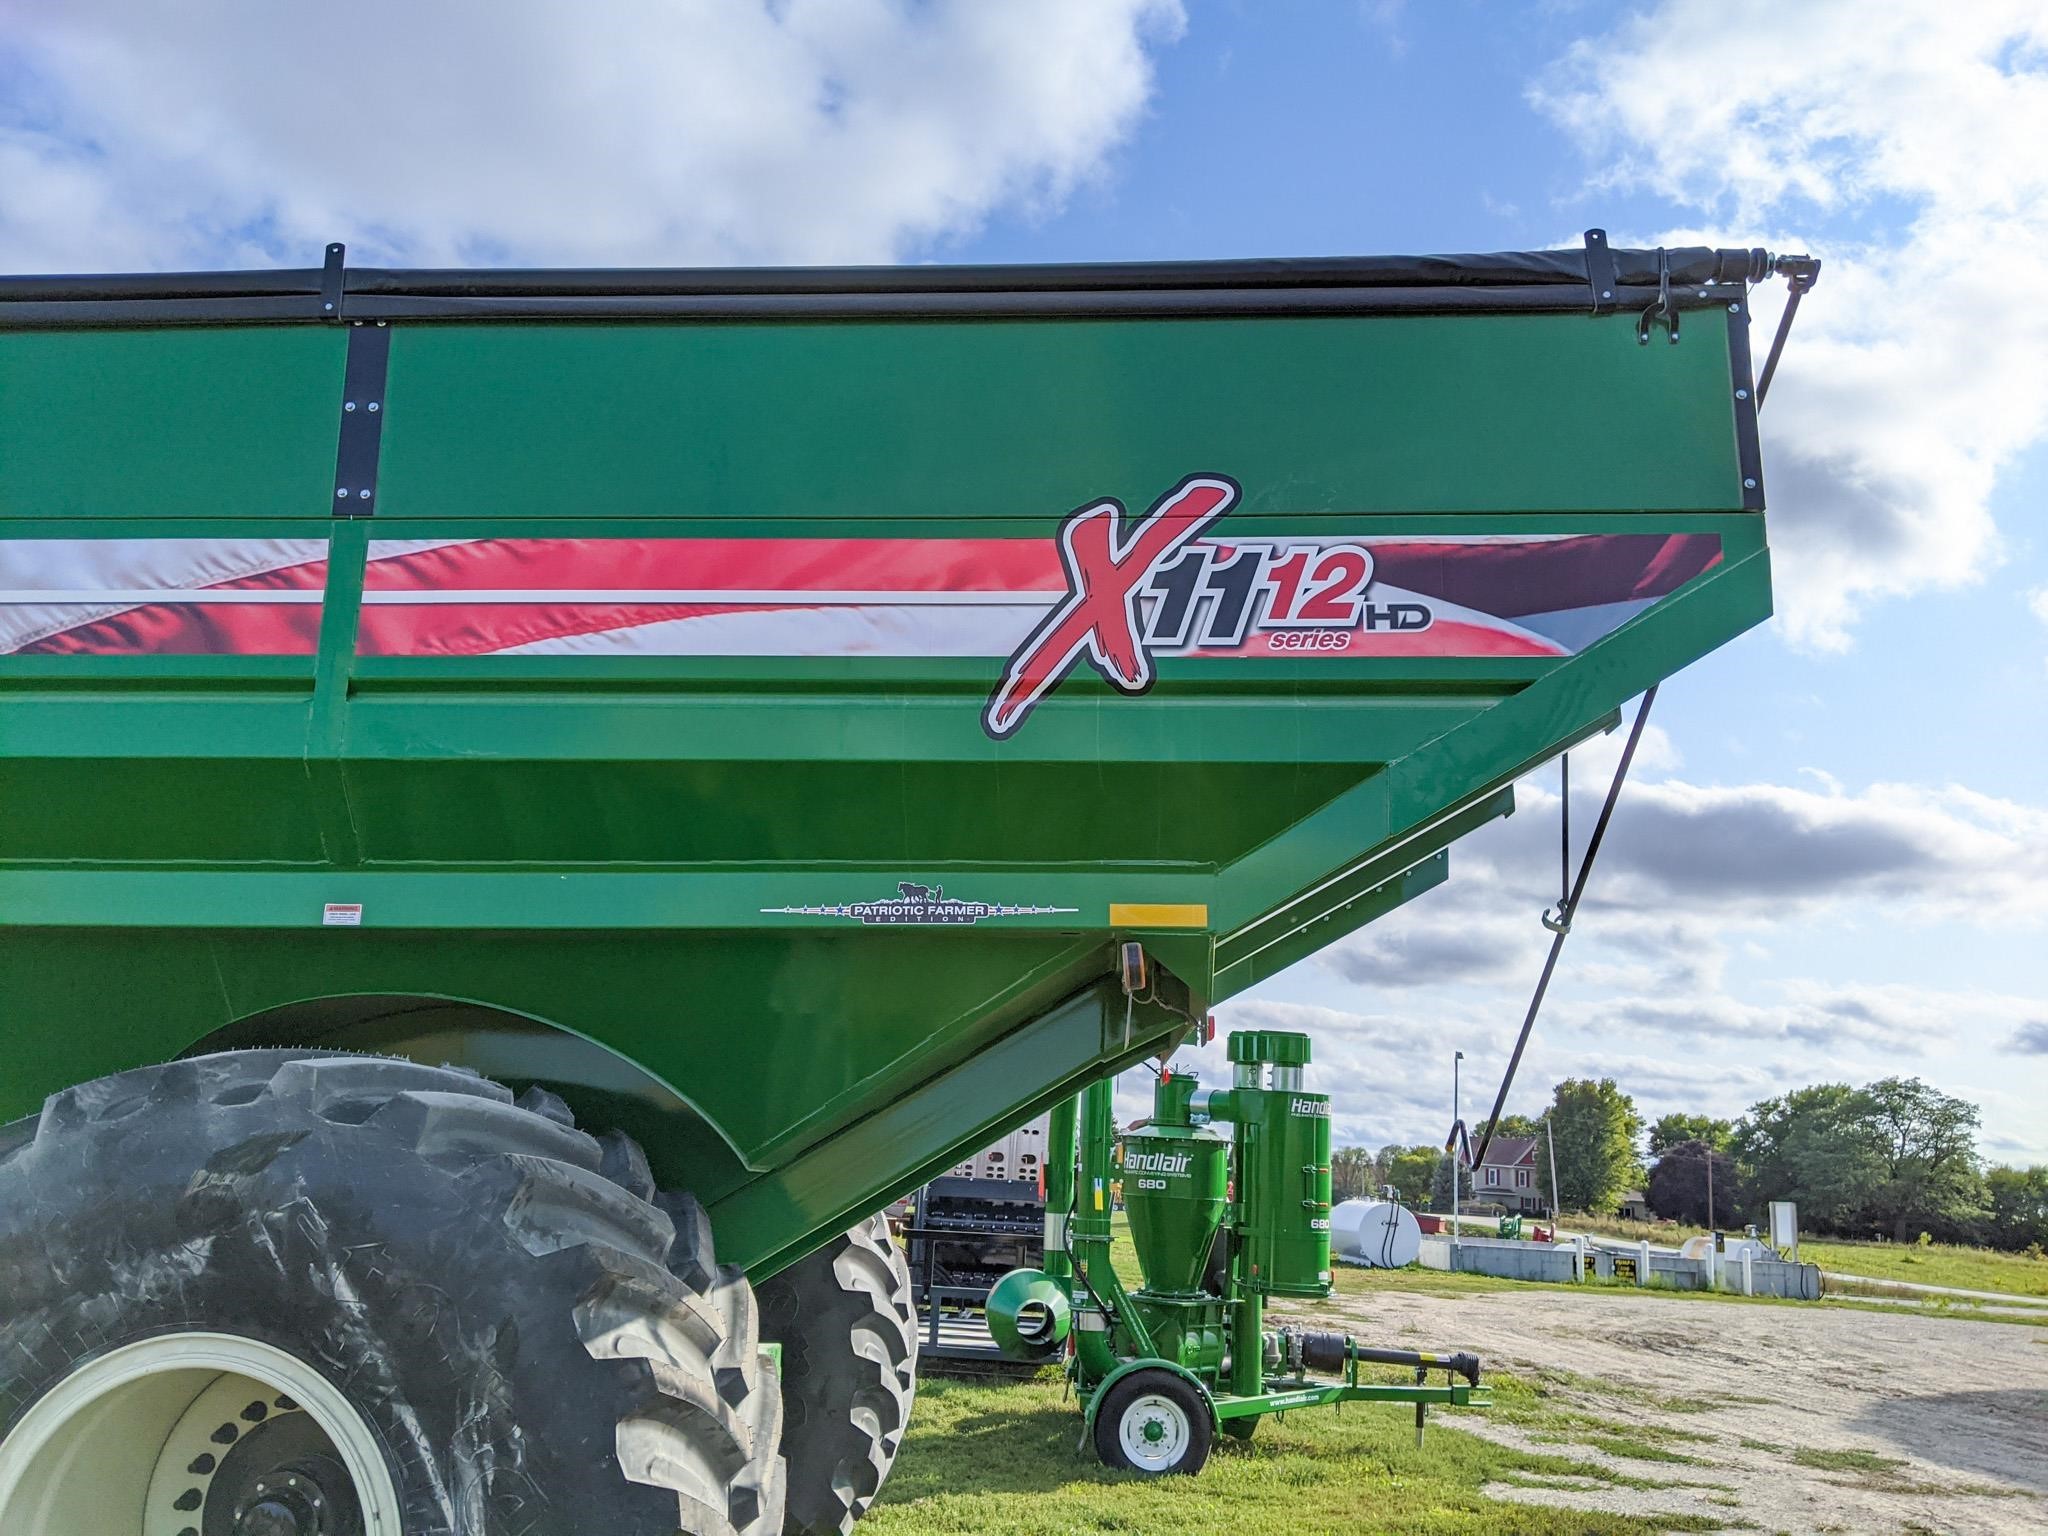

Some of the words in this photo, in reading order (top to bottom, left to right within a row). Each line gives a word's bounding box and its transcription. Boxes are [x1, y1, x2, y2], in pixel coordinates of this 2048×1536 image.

[1365, 604, 1432, 632] HD
[1269, 627, 1350, 650] series
[854, 905, 924, 916] PATRIOTIC
[927, 905, 985, 916] FARMER
[1124, 1152, 1193, 1173] Handlair
[1138, 1179, 1166, 1190] 680
